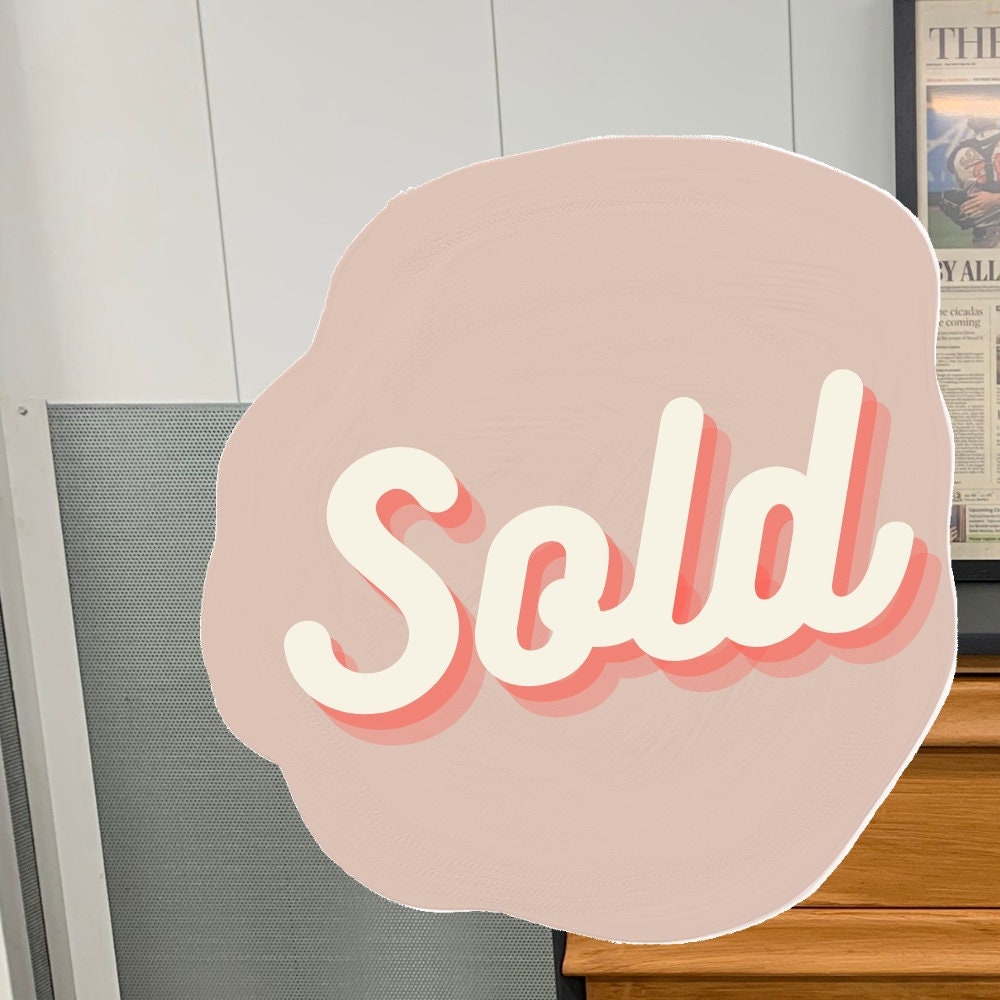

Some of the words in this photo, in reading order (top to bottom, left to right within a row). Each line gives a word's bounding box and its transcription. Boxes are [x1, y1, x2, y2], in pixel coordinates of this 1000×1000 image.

[961, 260, 1000, 282] ALL
[949, 306, 984, 316] cicadas
[945, 317, 981, 328] coming
